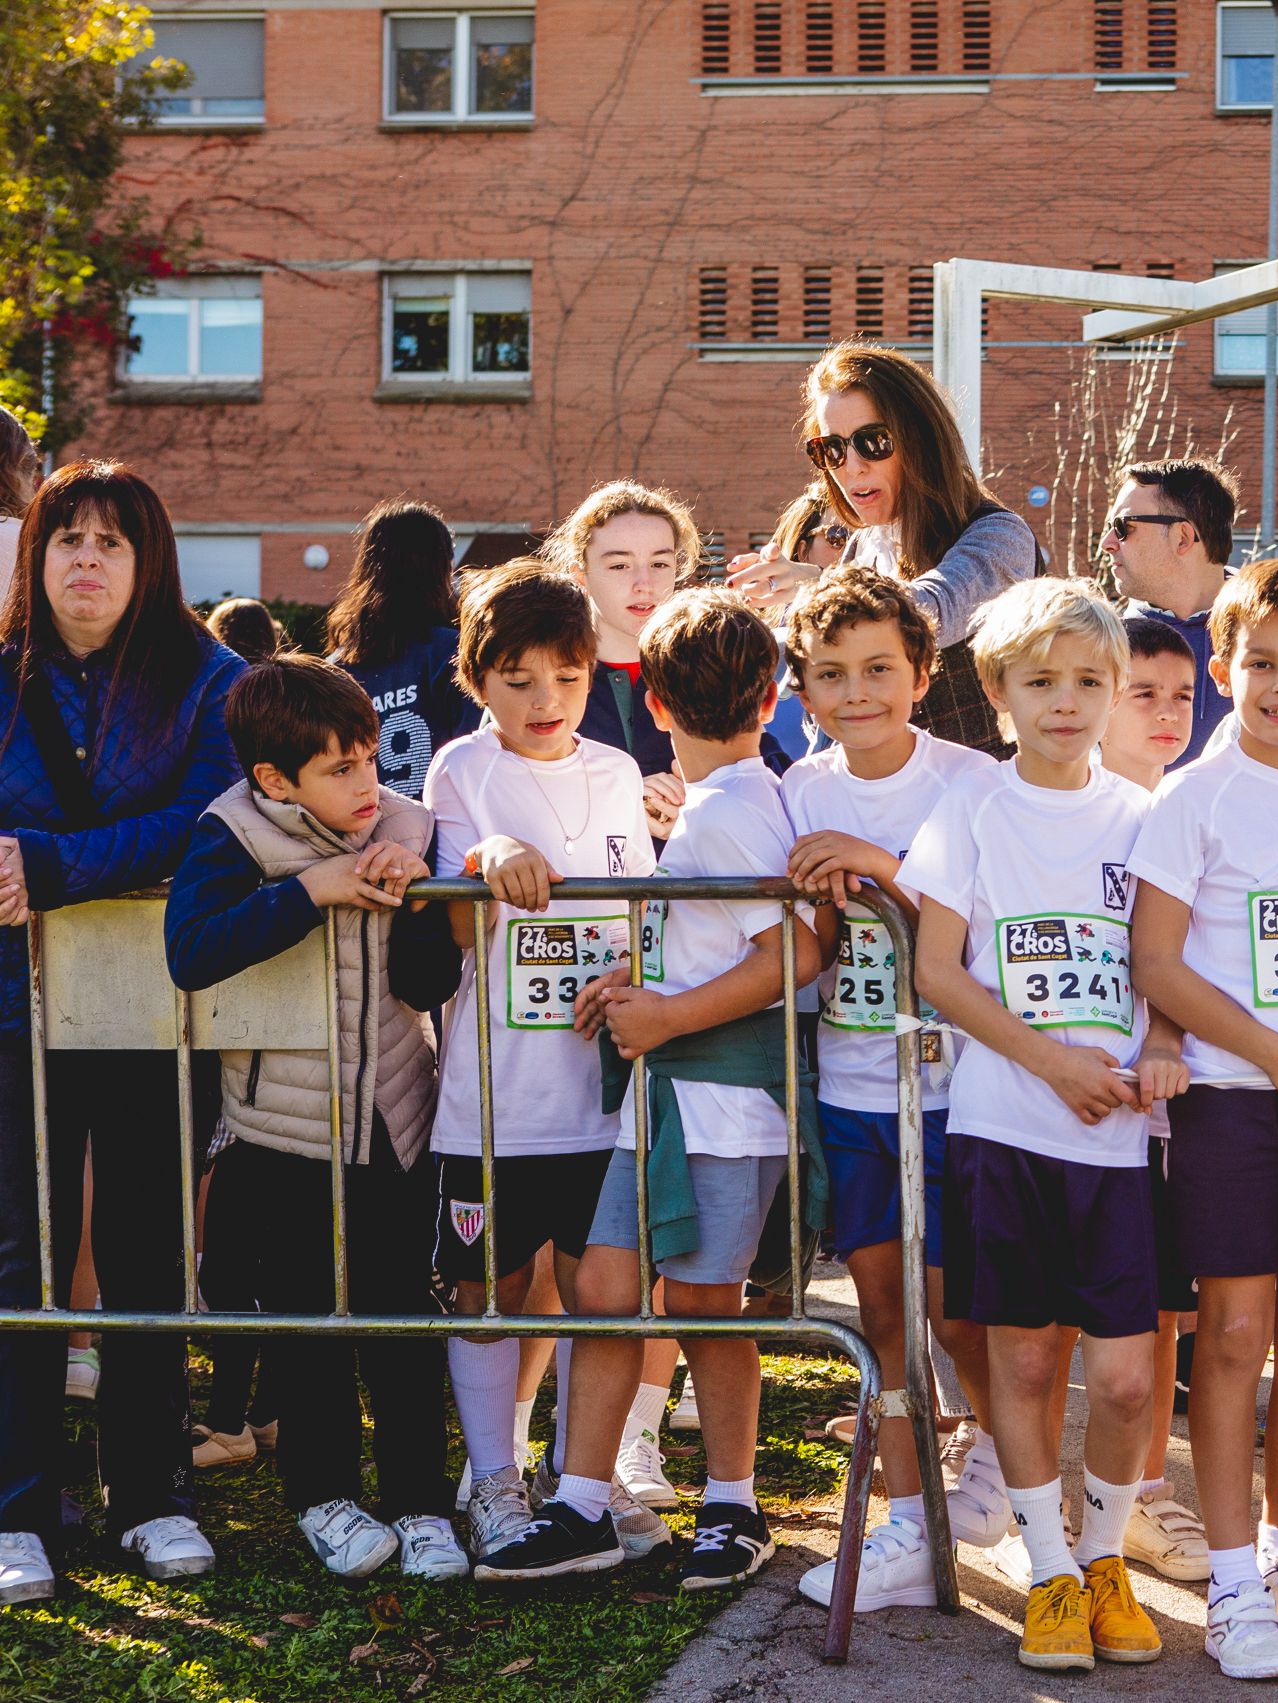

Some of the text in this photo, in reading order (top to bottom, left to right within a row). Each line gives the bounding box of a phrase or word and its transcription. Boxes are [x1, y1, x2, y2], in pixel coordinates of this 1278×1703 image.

[520, 941, 574, 959] CROS
[1010, 935, 1067, 955] CROS
[528, 975, 600, 1004] 33
[840, 977, 896, 1006] 25
[1026, 972, 1120, 1003] 3241
